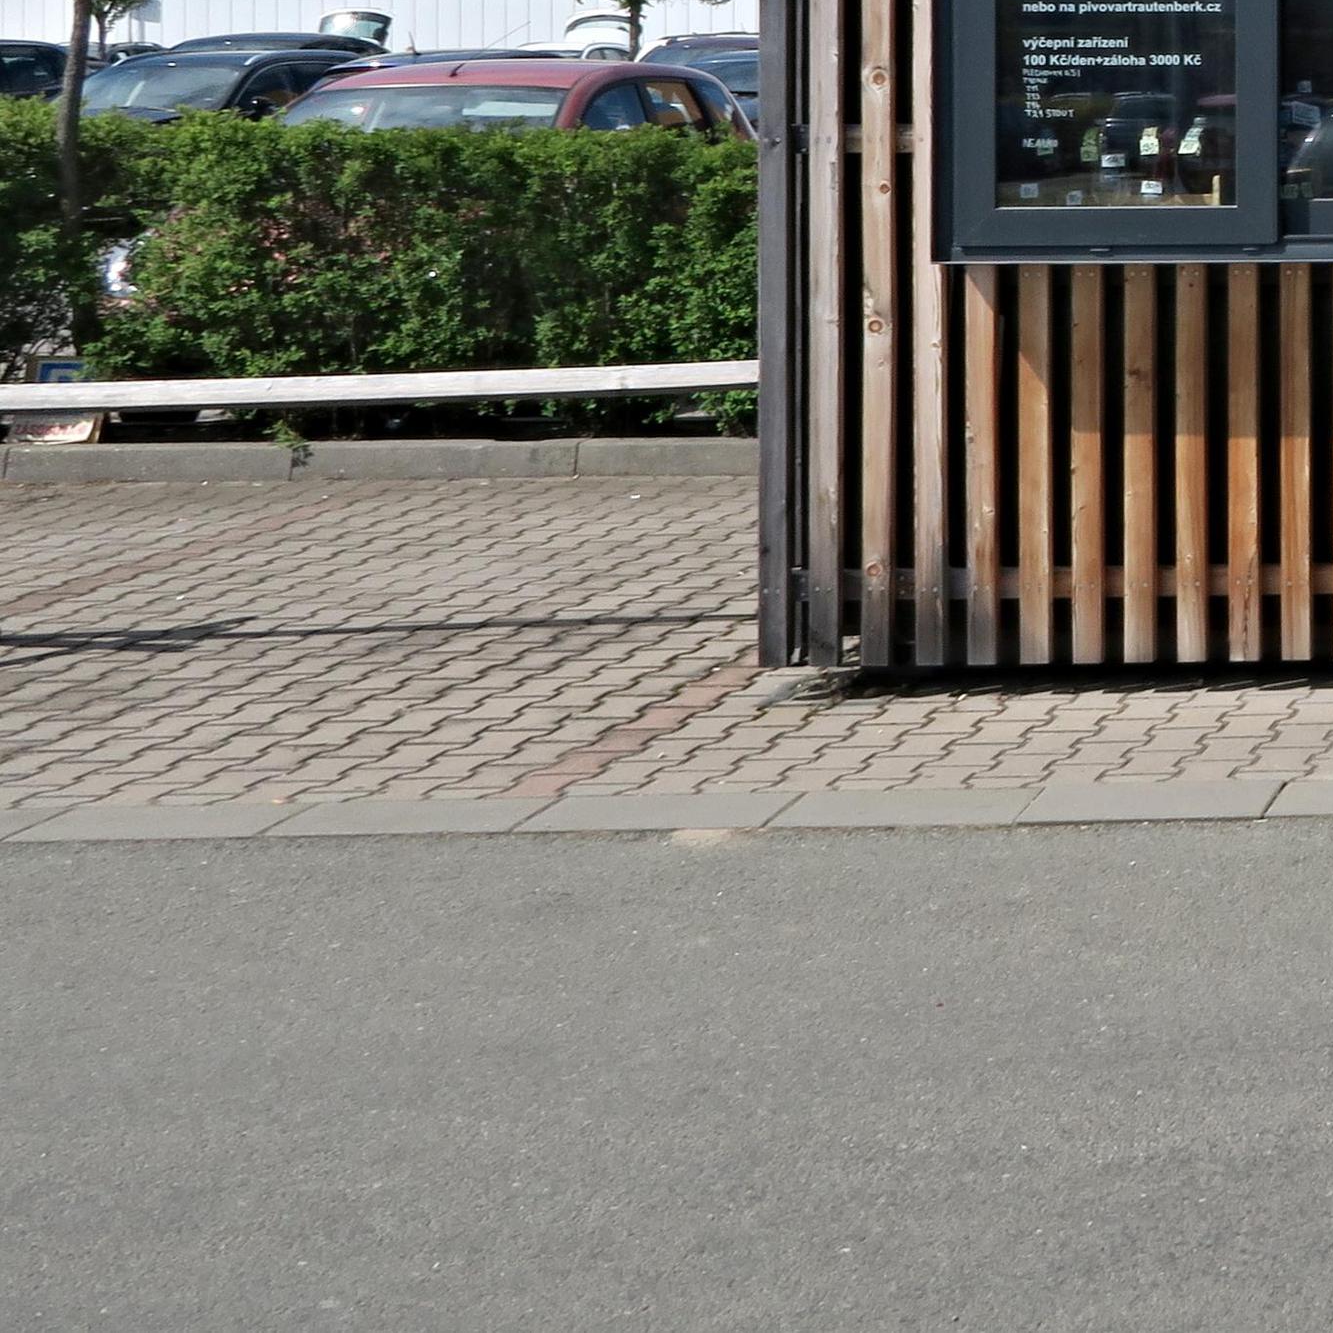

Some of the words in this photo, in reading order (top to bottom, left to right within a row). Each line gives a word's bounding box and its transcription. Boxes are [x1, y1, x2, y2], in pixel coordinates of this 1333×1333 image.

[1022, 1, 1056, 12] nebo
[1059, 3, 1076, 12] na
[1079, 1, 1222, 14] pivovartrautenberk.cz
[1022, 36, 1075, 51] výčepní
[1077, 36, 1129, 48] zařízení
[1023, 55, 1046, 66] 100
[1149, 55, 1181, 66] 3000
[1183, 54, 1202, 66] Kč
